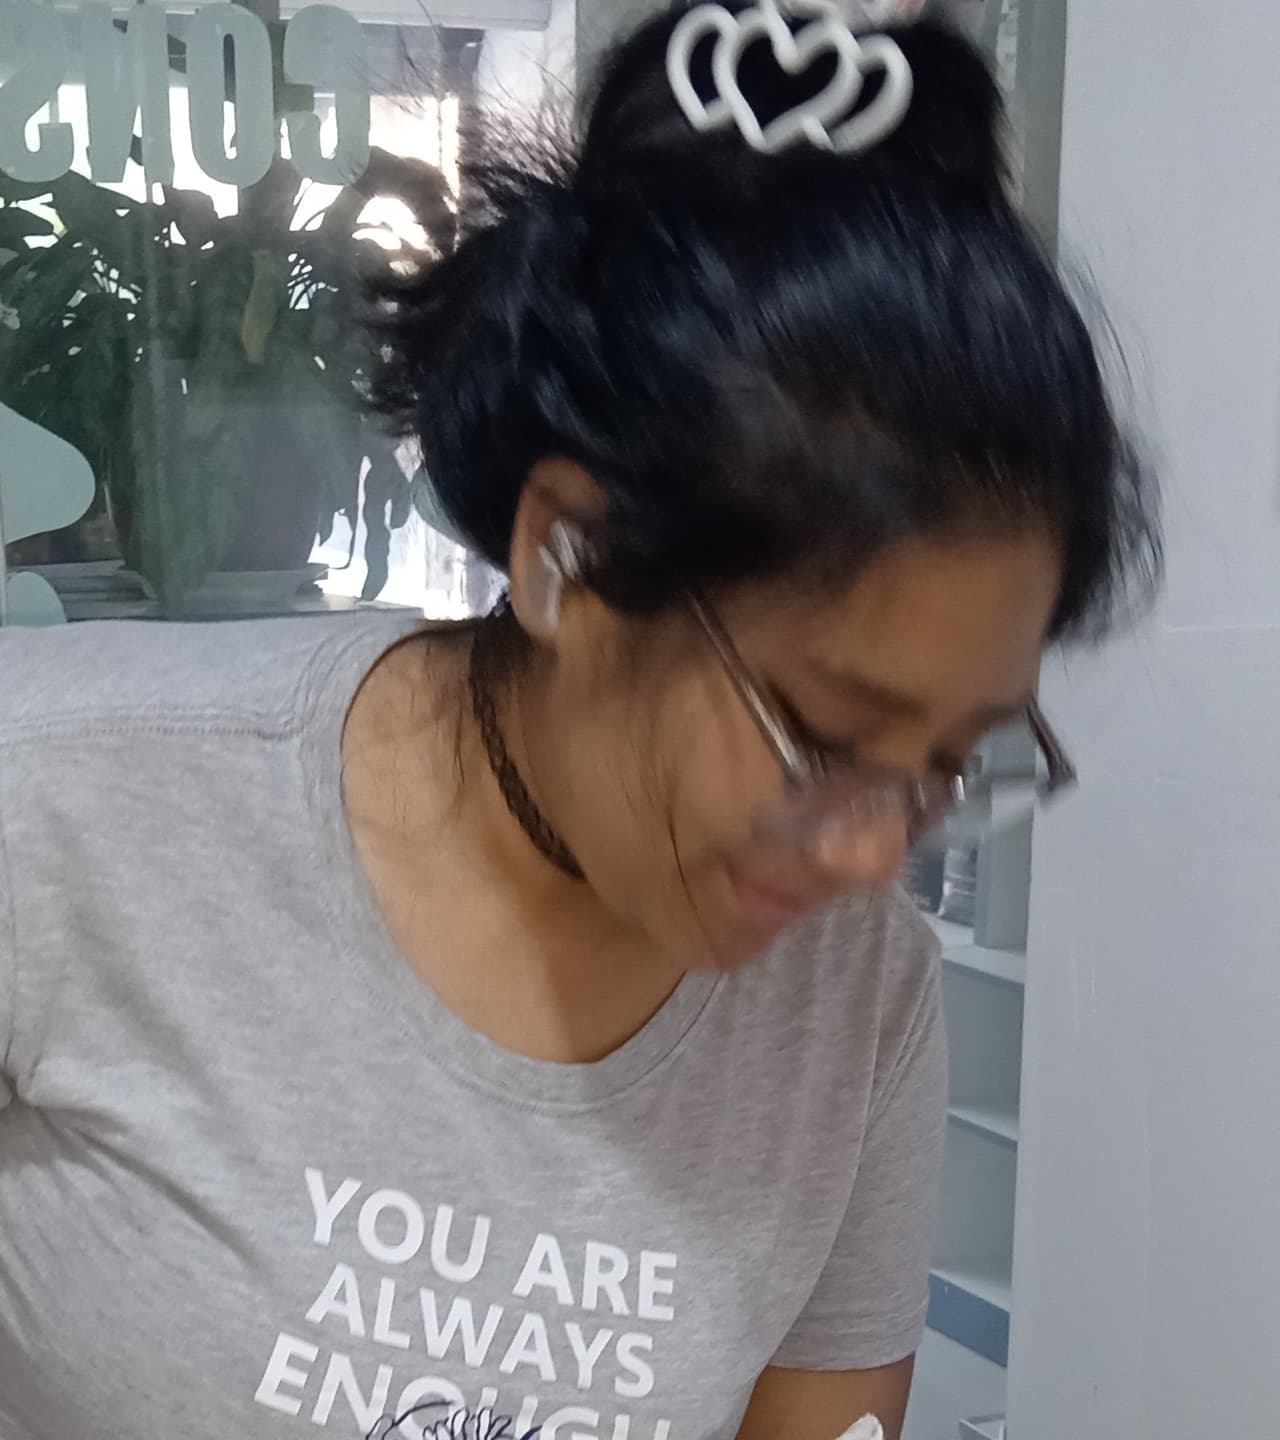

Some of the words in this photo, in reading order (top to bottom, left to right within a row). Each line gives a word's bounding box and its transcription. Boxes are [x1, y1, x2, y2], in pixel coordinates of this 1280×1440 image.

[304, 1167, 491, 1283] YOU
[512, 1233, 678, 1321] ARE
[305, 1263, 656, 1398] ALWAYS
